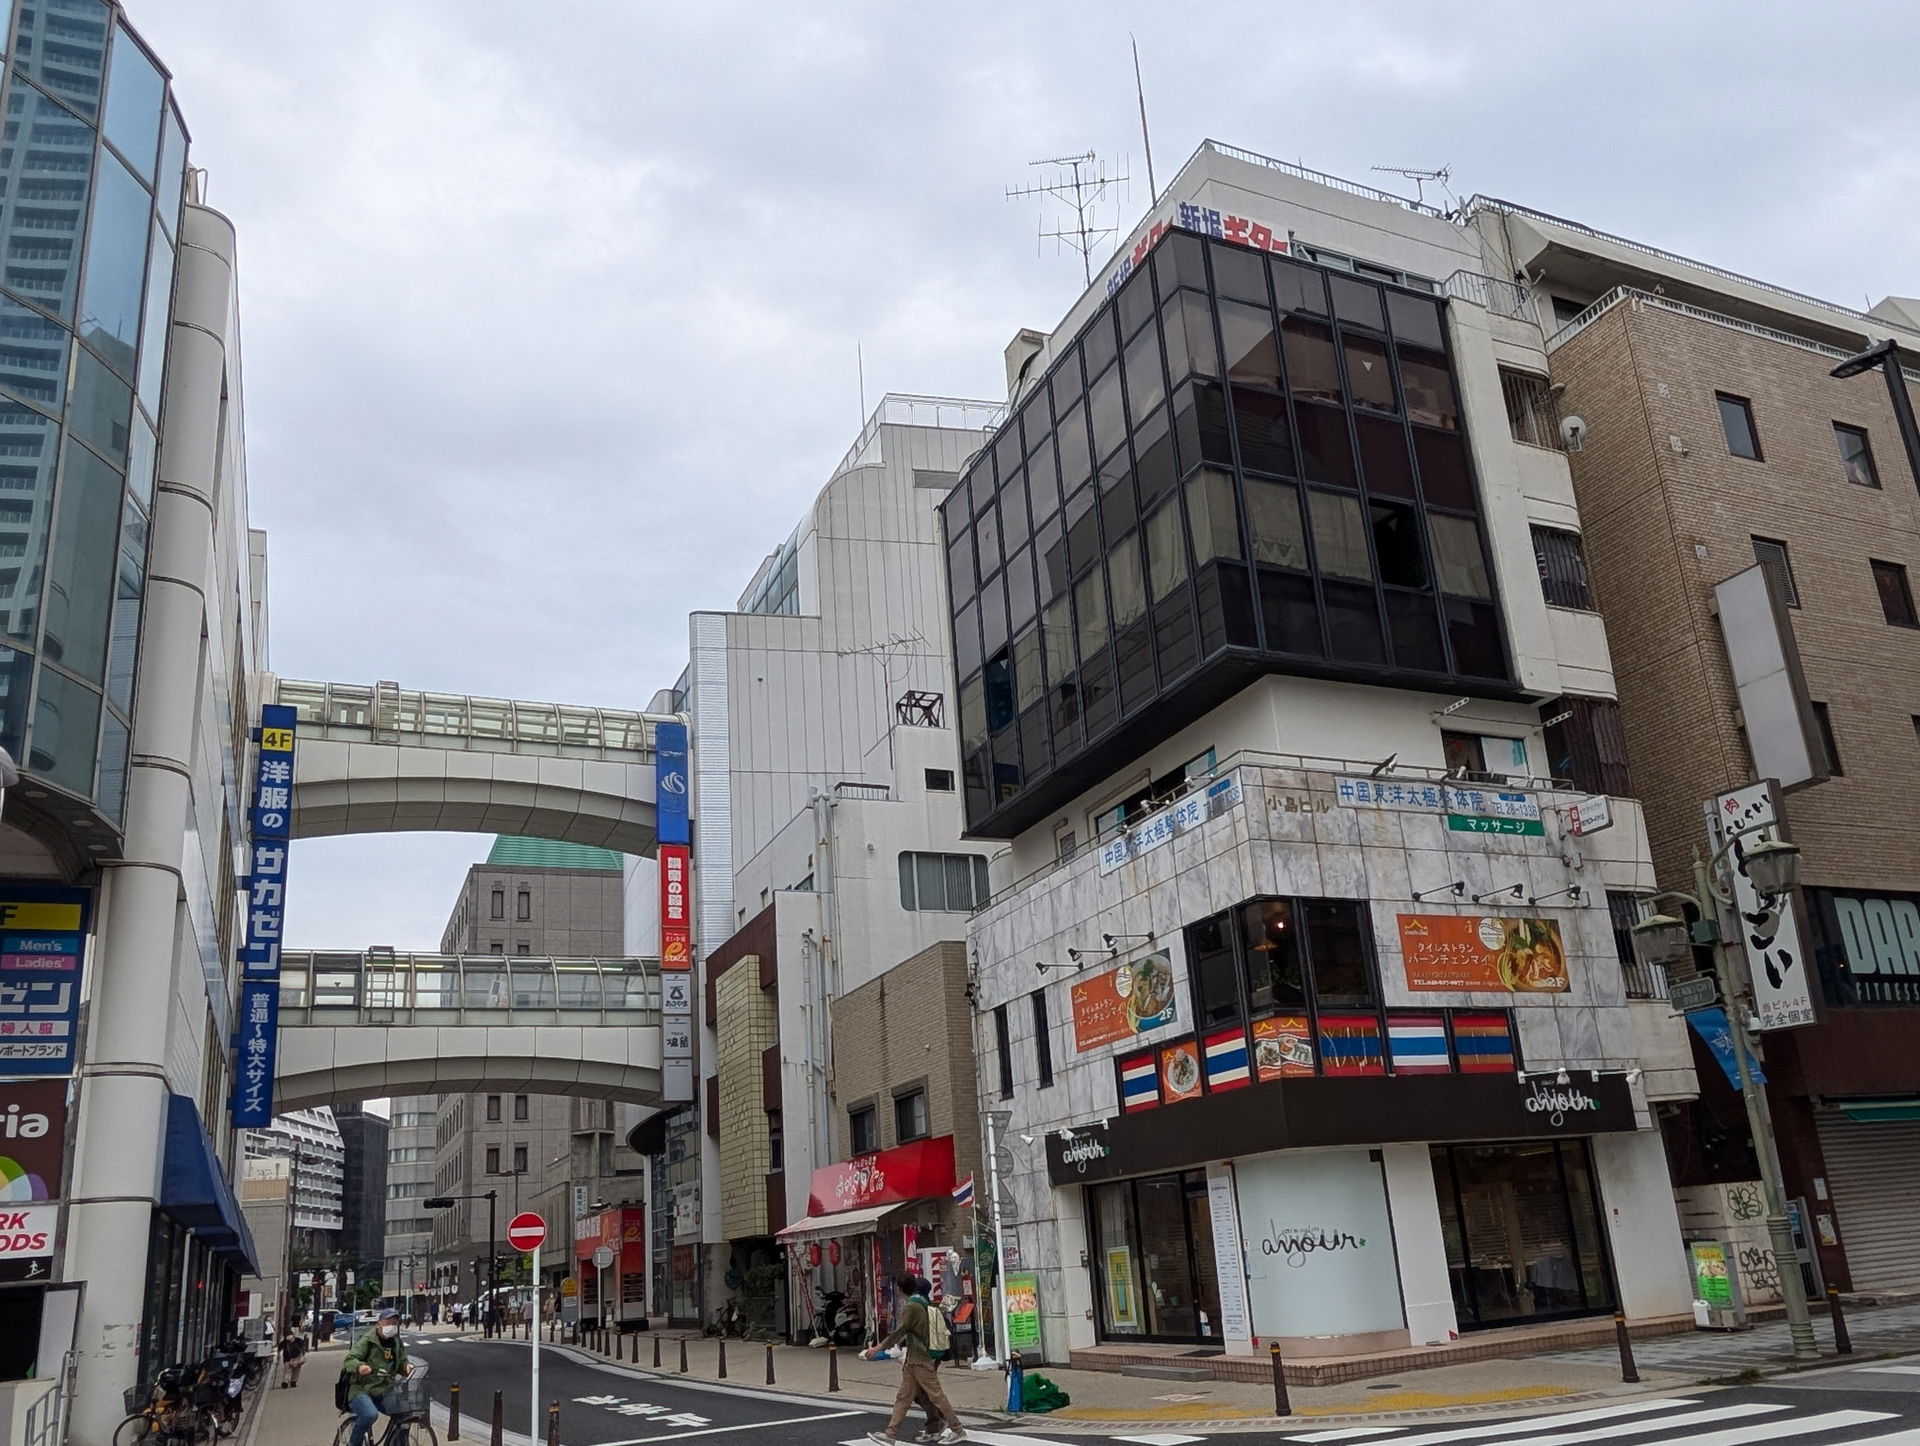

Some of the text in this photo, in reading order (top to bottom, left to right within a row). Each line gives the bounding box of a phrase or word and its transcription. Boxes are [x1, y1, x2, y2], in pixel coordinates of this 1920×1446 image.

[264, 731, 291, 747] 4F
[260, 759, 290, 828] 洋服の
[1726, 794, 1771, 835] SUSHI
[1467, 819, 1525, 833] マッサージ
[248, 846, 284, 971] サカゼン
[20, 940, 62, 951] Men's
[1418, 943, 1474, 953] タイレストラン
[1546, 977, 1565, 987] 2F
[1160, 1007, 1174, 1021] 2F
[1763, 1009, 1814, 1028] 完全個室
[1, 1022, 54, 1034] 婦人服
